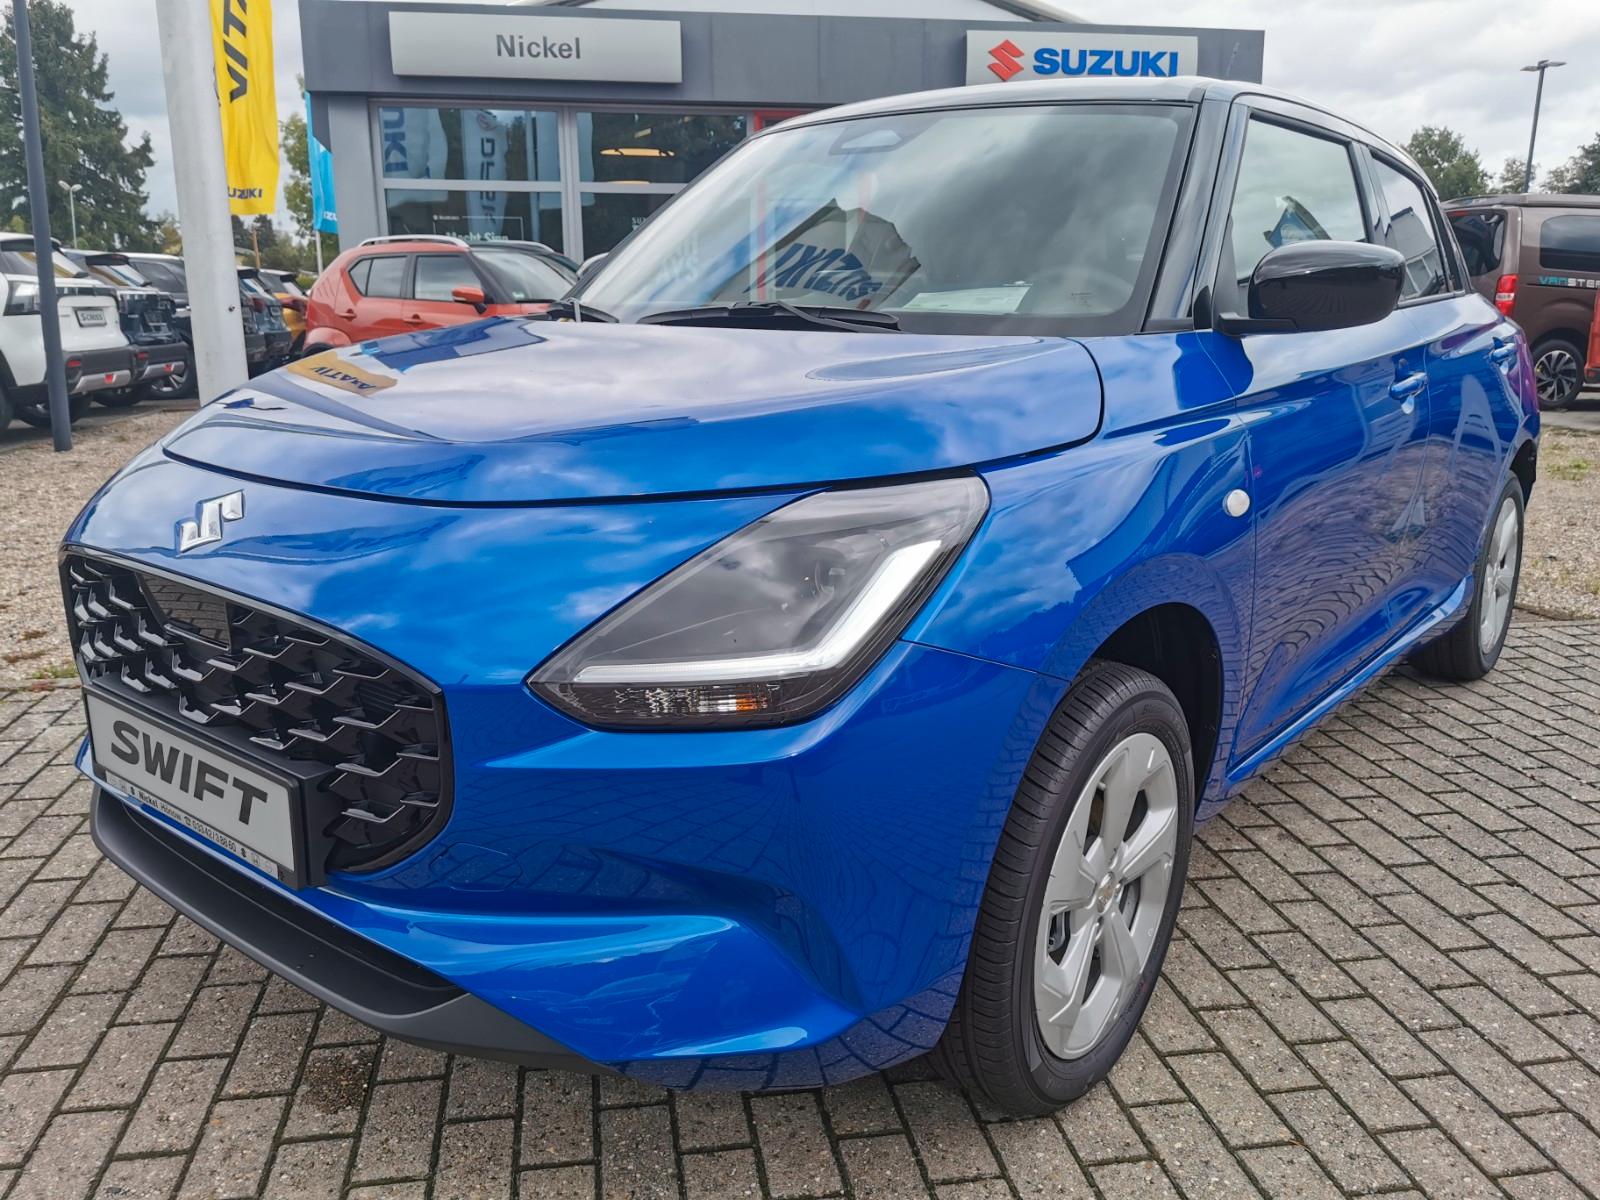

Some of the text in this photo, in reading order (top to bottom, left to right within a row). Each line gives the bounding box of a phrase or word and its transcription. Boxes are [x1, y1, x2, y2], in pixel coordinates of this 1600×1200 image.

[495, 34, 581, 60] Nickel
[1032, 47, 1180, 77] SUZUKI
[228, 187, 263, 200] UZUKI
[111, 720, 268, 825] SWIFT
